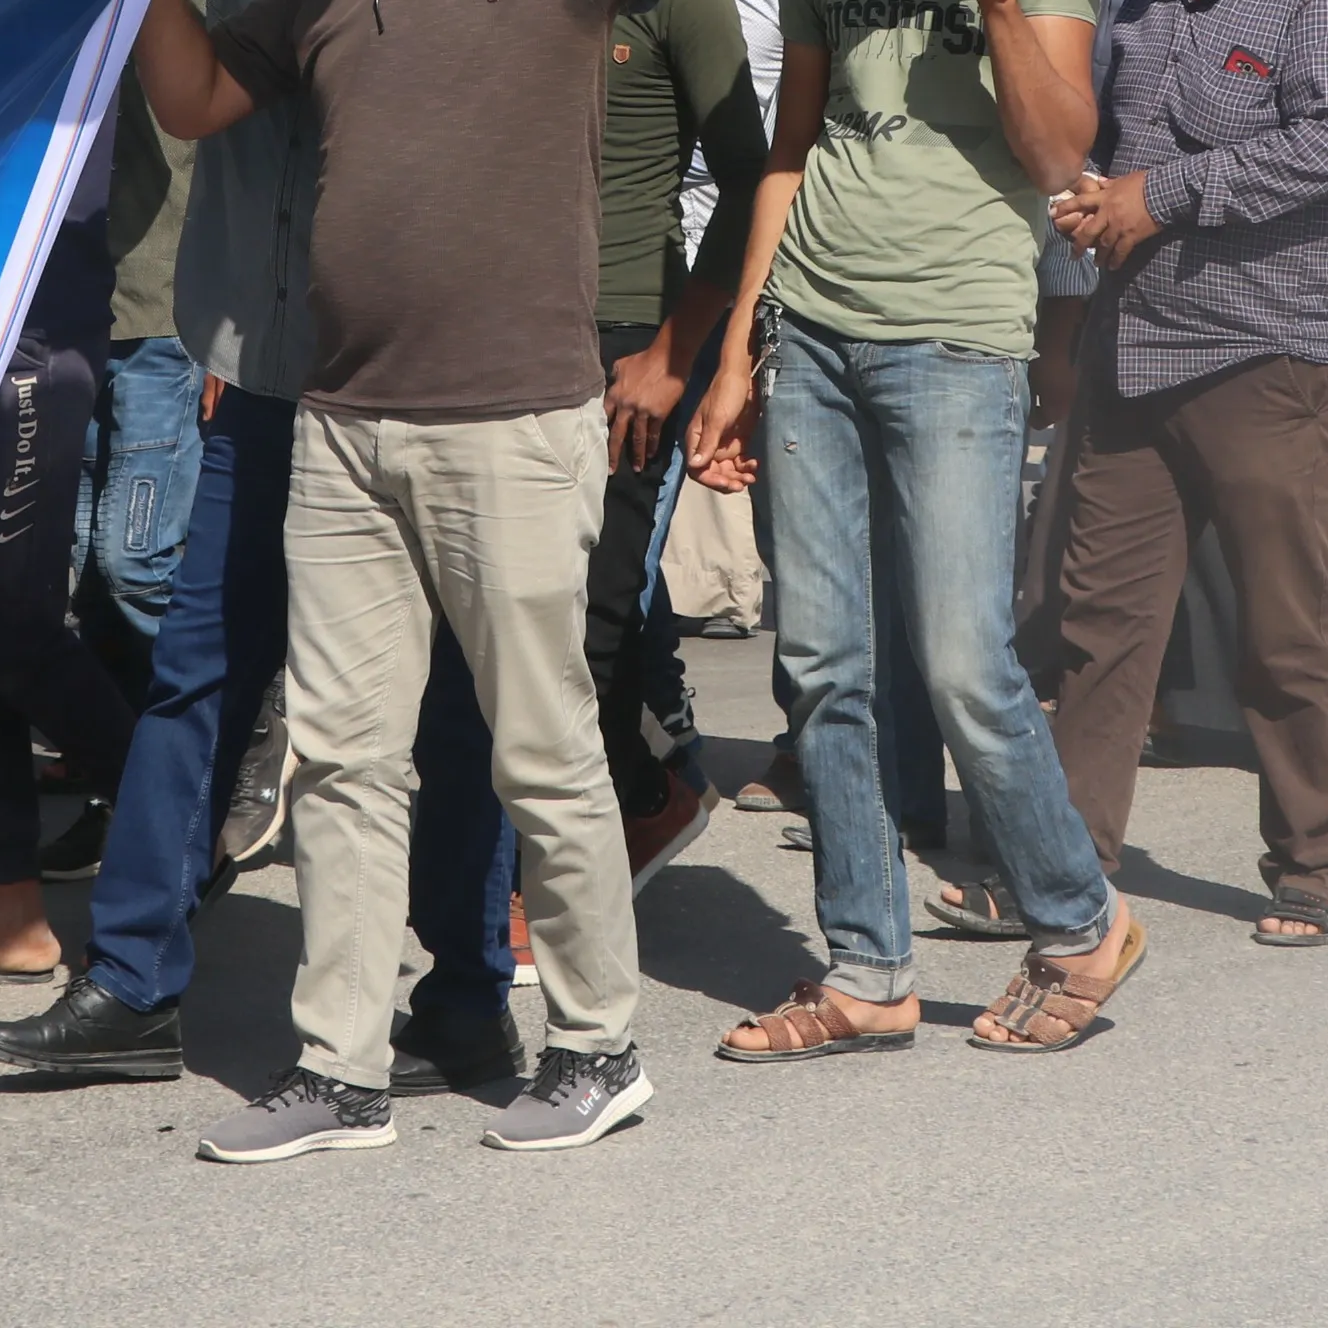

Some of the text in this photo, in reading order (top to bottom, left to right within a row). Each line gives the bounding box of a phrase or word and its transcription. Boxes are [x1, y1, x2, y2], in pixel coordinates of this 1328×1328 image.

[11, 375, 38, 482] Just Do It.
[575, 1086, 602, 1116] LIFE
